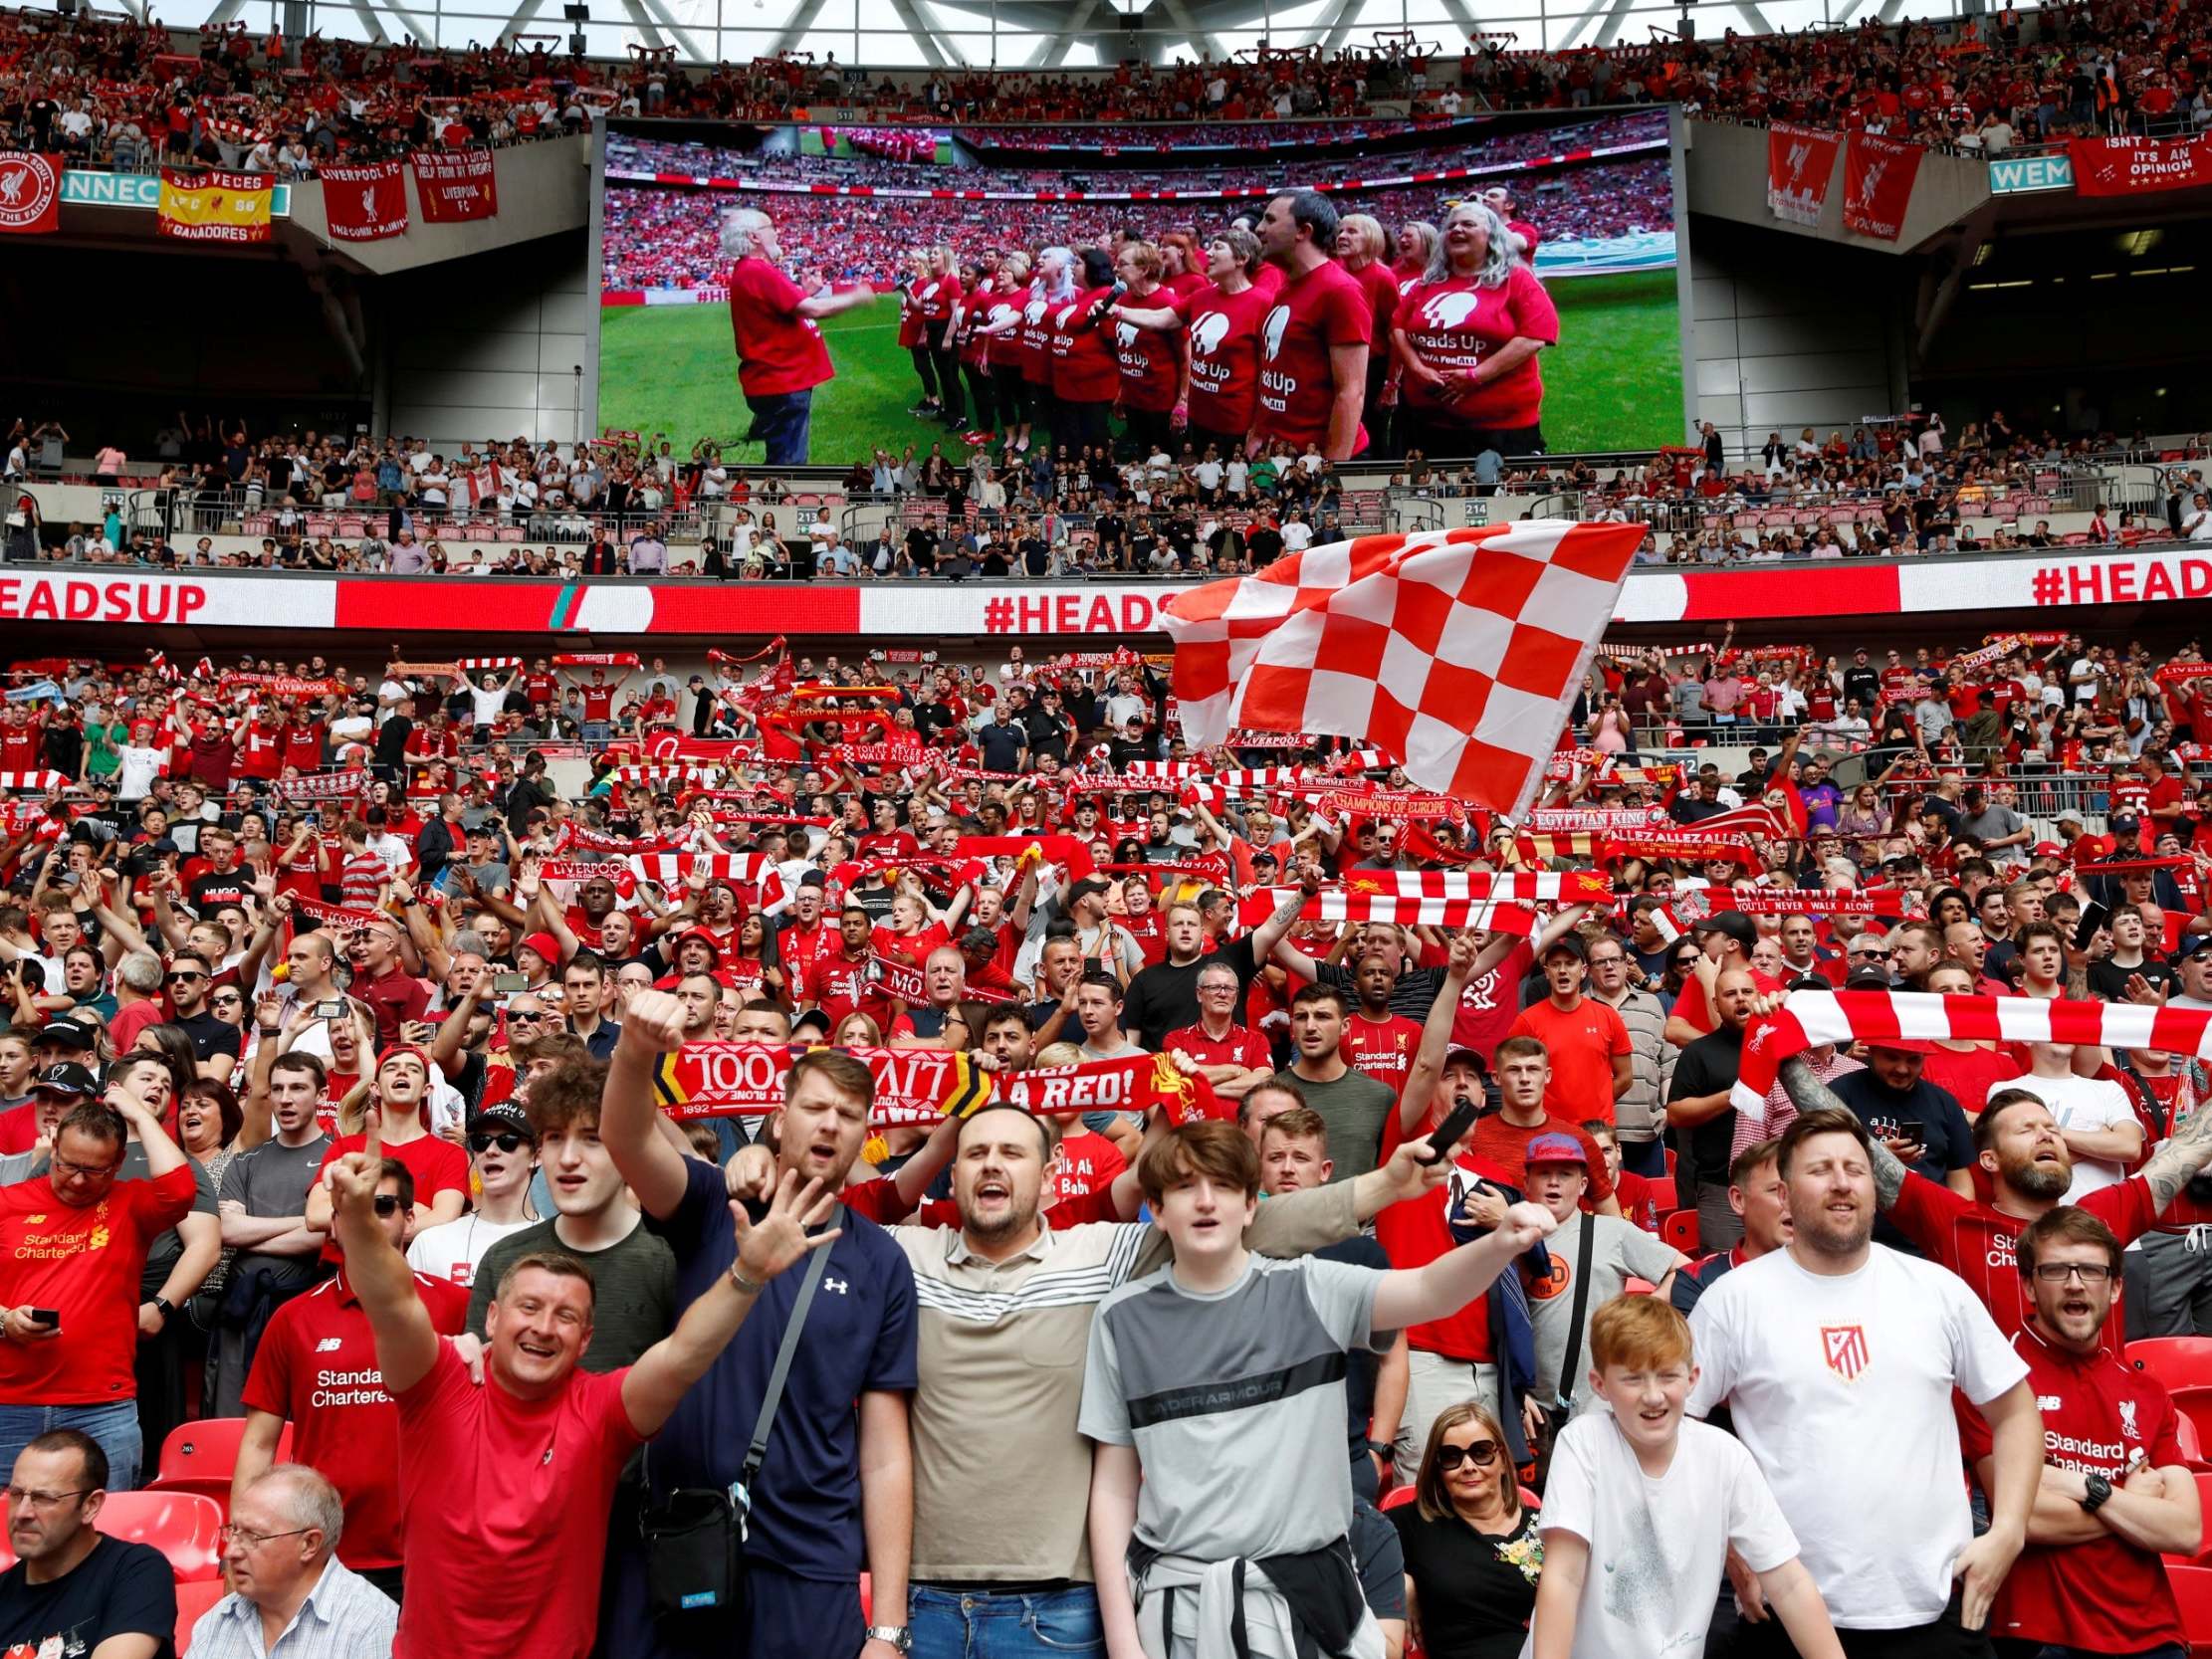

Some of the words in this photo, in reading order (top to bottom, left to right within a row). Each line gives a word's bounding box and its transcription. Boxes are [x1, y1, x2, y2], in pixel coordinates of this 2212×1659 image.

[838, 110, 853, 120] 513
[2133, 150, 2159, 162] IT'S
[2170, 147, 2190, 161] AN
[30, 155, 51, 184] SOUL
[320, 167, 384, 182] LIVERPOOL
[386, 162, 400, 176] FC
[416, 164, 435, 179] HELP
[437, 164, 456, 178] FROM
[1992, 159, 2072, 188] WEM
[2129, 158, 2193, 175] OPINION
[211, 172, 263, 190] VECES
[60, 175, 158, 203] NNEC
[441, 184, 480, 200] LIVERPOOL
[24, 194, 51, 220] FAITH
[456, 200, 471, 213] FC
[172, 225, 248, 241] GANADORES
[1460, 334, 1487, 353] Up
[1133, 353, 1149, 368] Up
[1209, 363, 1229, 381] Up
[1272, 372, 1297, 394] Up
[103, 494, 124, 506] 212
[797, 512, 817, 522] 213
[1465, 504, 1487, 515] 214
[1076, 652, 1114, 663] LIVERPOOL
[1962, 637, 2022, 669] CHAMPIONS
[274, 682, 329, 693] LIVERPOOL
[1240, 735, 1301, 745] LIVERPOOL
[856, 744, 888, 754] YOU'LL
[890, 745, 922, 756] NEVER
[858, 752, 887, 761] WALK
[890, 752, 921, 763] ALONE
[1103, 780, 1127, 789] NEVER
[1129, 781, 1150, 790] WALK
[1151, 782, 1175, 792] ALONE
[1299, 776, 1315, 786] THE
[1314, 776, 1349, 788] NORMAL
[1348, 779, 1367, 788] ONE
[1333, 793, 1391, 813] CHAMPIONS
[1392, 800, 1408, 814] OF
[1408, 800, 1446, 815] EUROPE
[1370, 793, 1410, 803] LIVERPOOL
[725, 811, 800, 821] LIVERPOOL
[1537, 810, 1608, 826] EGYPTIAN
[1610, 810, 1647, 825] KING
[573, 837, 592, 847] YOU'LL
[1610, 830, 1655, 842] ALLEZ
[1655, 831, 1702, 844] ALLEZ
[1702, 832, 1746, 848] ALLEZ
[204, 886, 240, 896] HUGO
[1732, 888, 1839, 903] LIVERPOOL
[1851, 888, 1875, 903] FC
[1736, 902, 1769, 913] YOU'LL
[1774, 901, 1804, 912] NEVER
[1810, 900, 1838, 911] WALK
[1844, 901, 1876, 913] ALONE
[909, 967, 925, 977] THE
[889, 969, 923, 995] MO
[964, 984, 977, 996] ING
[1354, 1051, 1397, 1062] Standard
[1353, 1061, 1397, 1072] Chartered
[730, 1090, 768, 1102] ALONE
[1009, 1080, 1031, 1110] A
[1040, 1068, 1135, 1109] RED!
[682, 1104, 711, 1115] 1892
[24, 1226, 89, 1245] Standard
[14, 1241, 87, 1260] Chartered
[317, 1366, 383, 1387] Standa
[1204, 1380, 1283, 1406] ARMOUR
[2044, 1430, 2124, 1460] Standard
